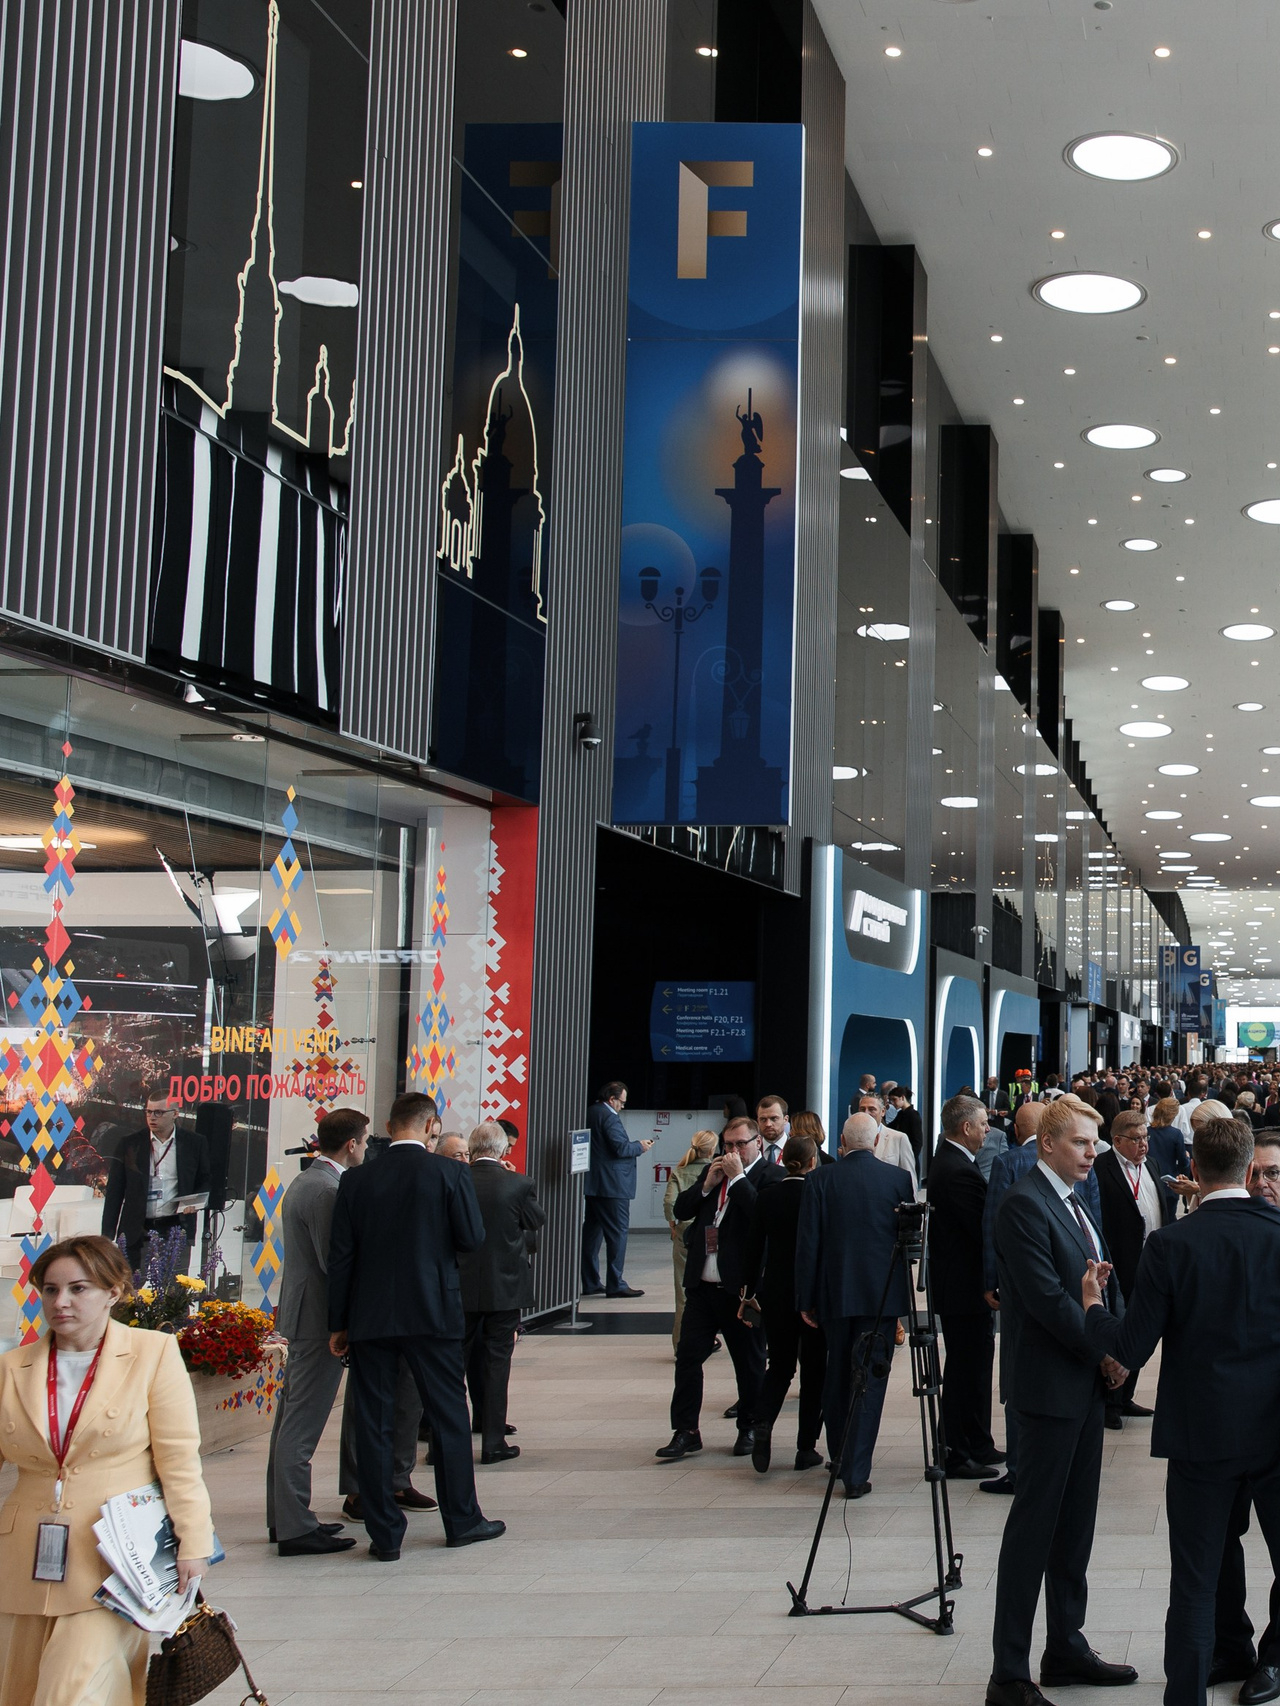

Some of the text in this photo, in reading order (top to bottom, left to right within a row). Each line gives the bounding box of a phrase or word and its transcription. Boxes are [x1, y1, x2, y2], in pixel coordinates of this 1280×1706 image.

[677, 161, 754, 279] F
[1183, 950, 1197, 966] G
[1200, 973, 1210, 987] G
[709, 988, 729, 996] F1.21
[211, 1026, 256, 1053] BINE
[292, 1029, 340, 1053] VENIT
[166, 1072, 367, 1108] ДОБРО ПОЖАЛОВАТЬ
